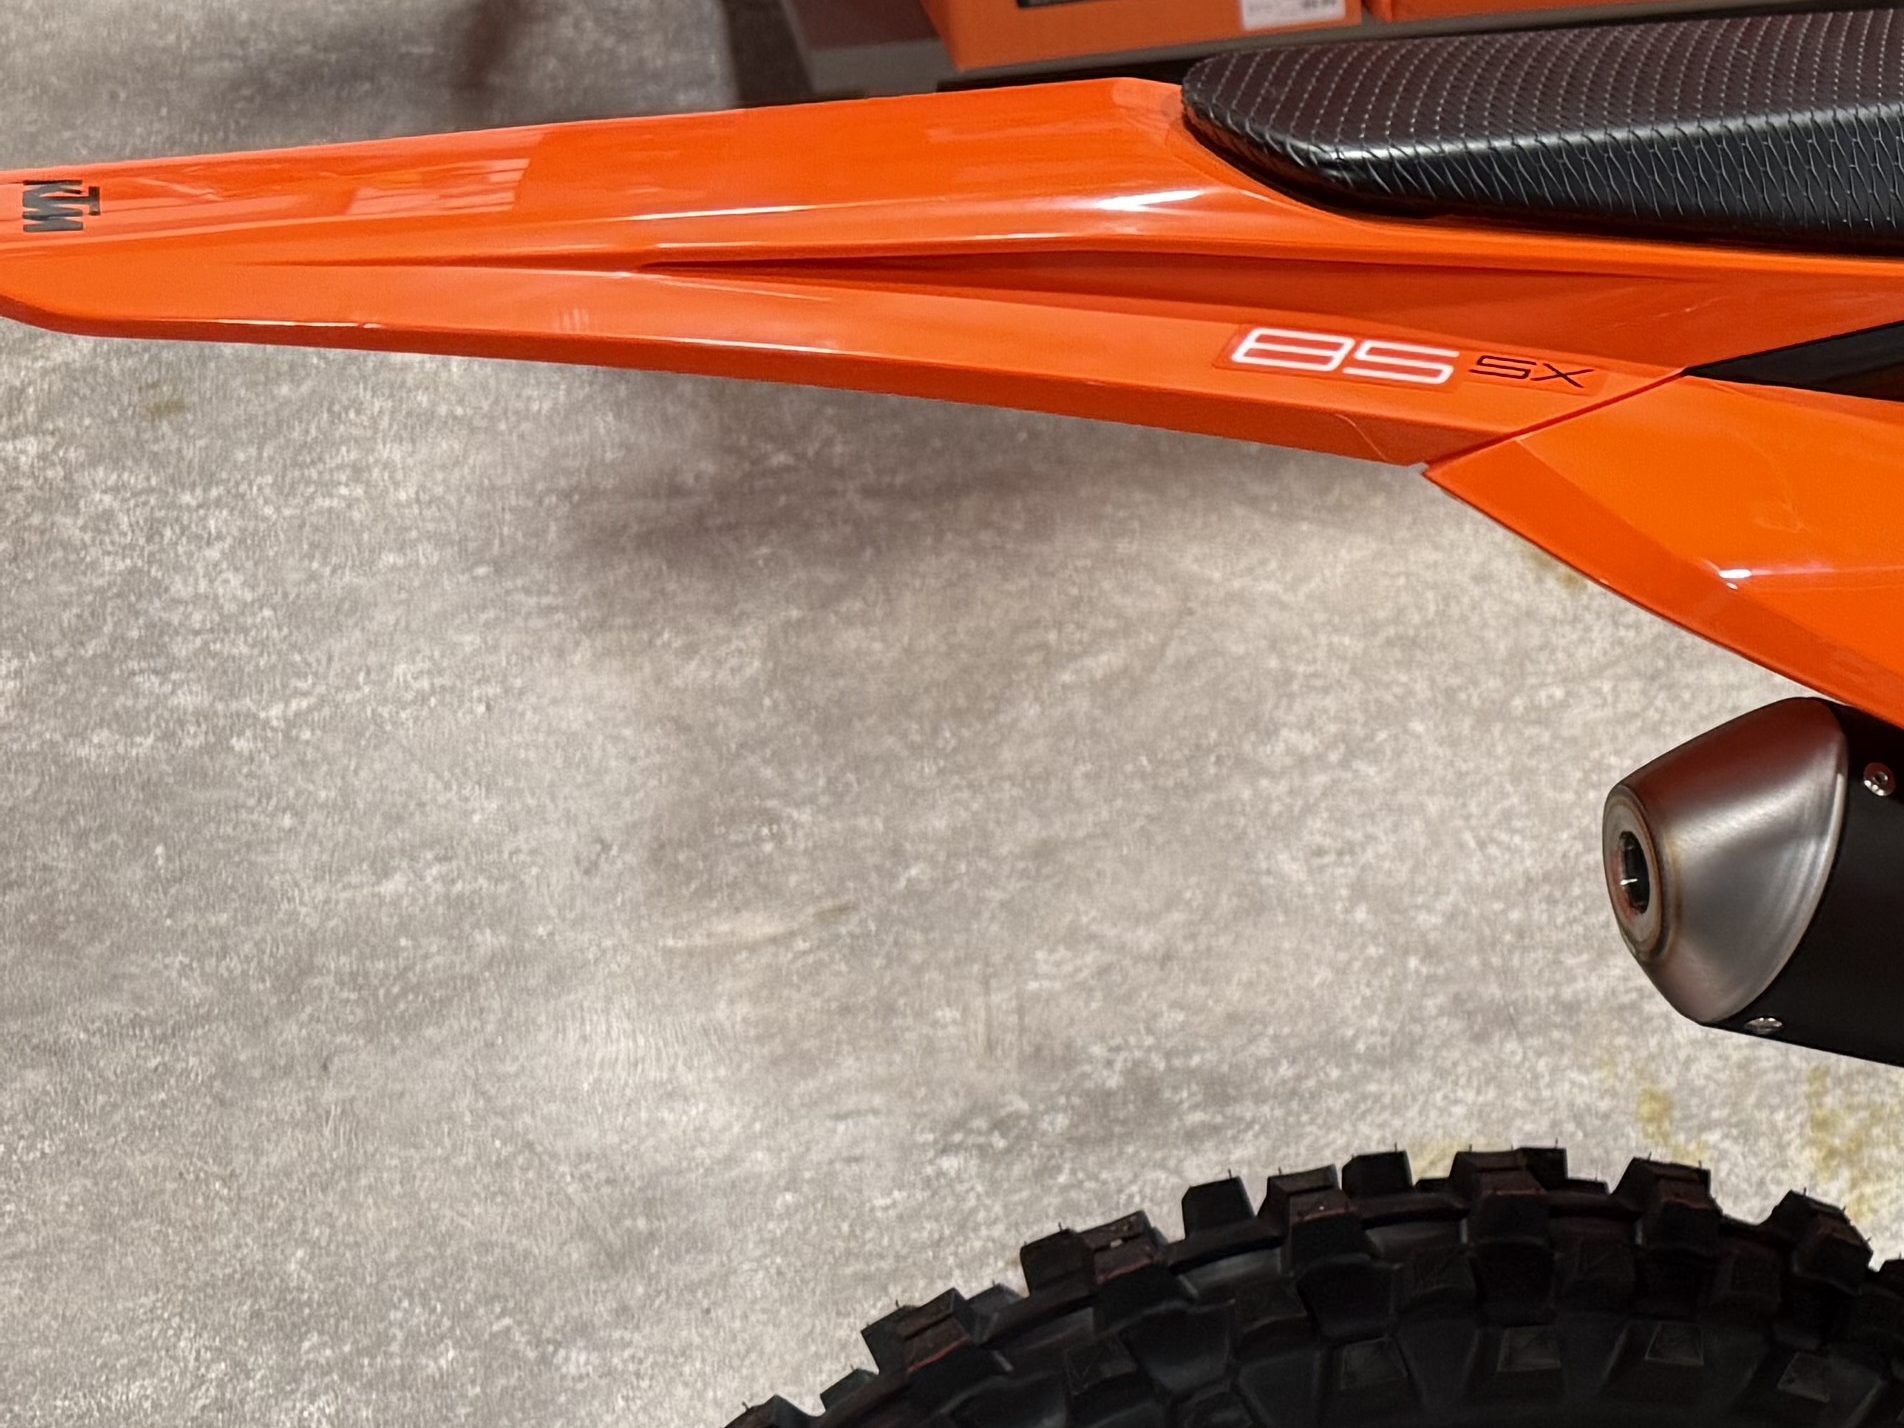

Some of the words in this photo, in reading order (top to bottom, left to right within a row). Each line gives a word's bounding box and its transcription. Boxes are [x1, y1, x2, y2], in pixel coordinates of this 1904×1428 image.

[22, 179, 101, 232] KTM
[1231, 327, 1460, 385] 85
[1468, 354, 1595, 389] SX
